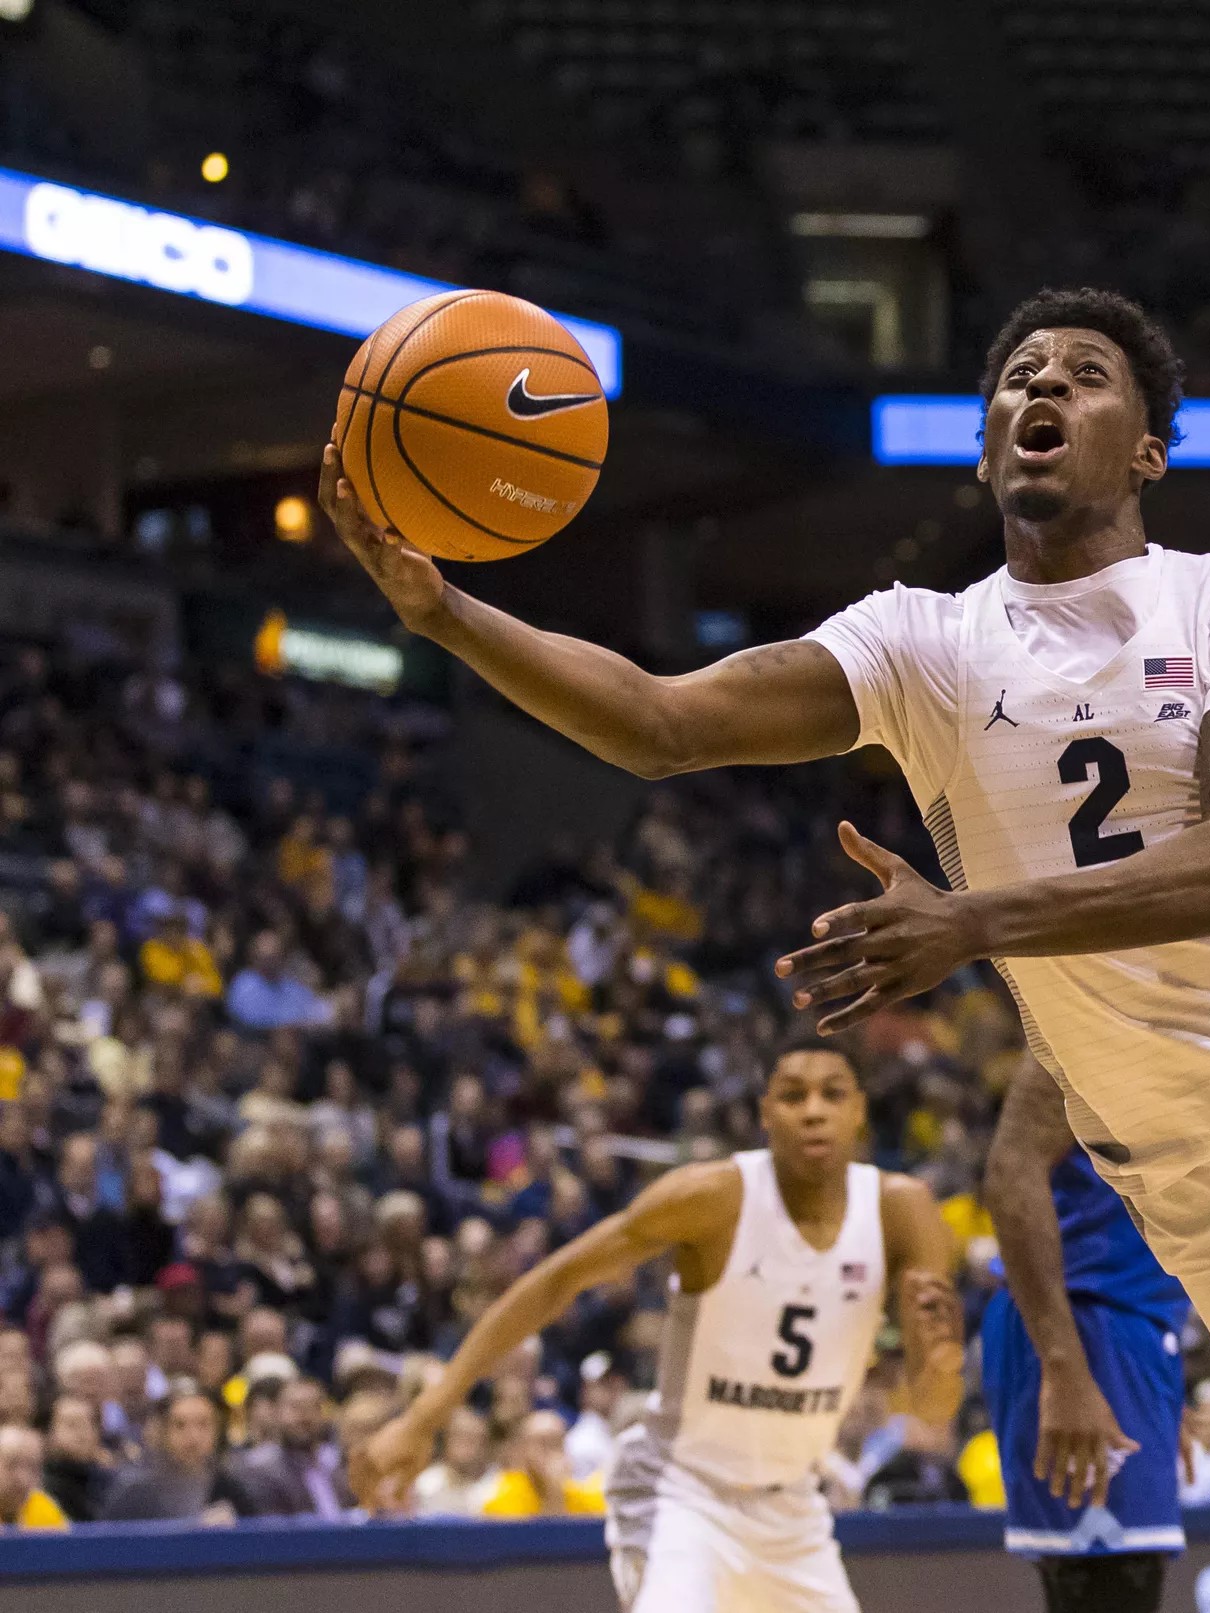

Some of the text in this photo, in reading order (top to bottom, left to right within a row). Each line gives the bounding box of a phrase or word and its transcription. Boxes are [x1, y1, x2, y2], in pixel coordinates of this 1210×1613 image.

[1072, 703, 1095, 722] AL
[1157, 710, 1192, 718] EAST
[1161, 703, 1185, 711] BIG
[1057, 736, 1145, 867] 2
[771, 1304, 816, 1377] 5
